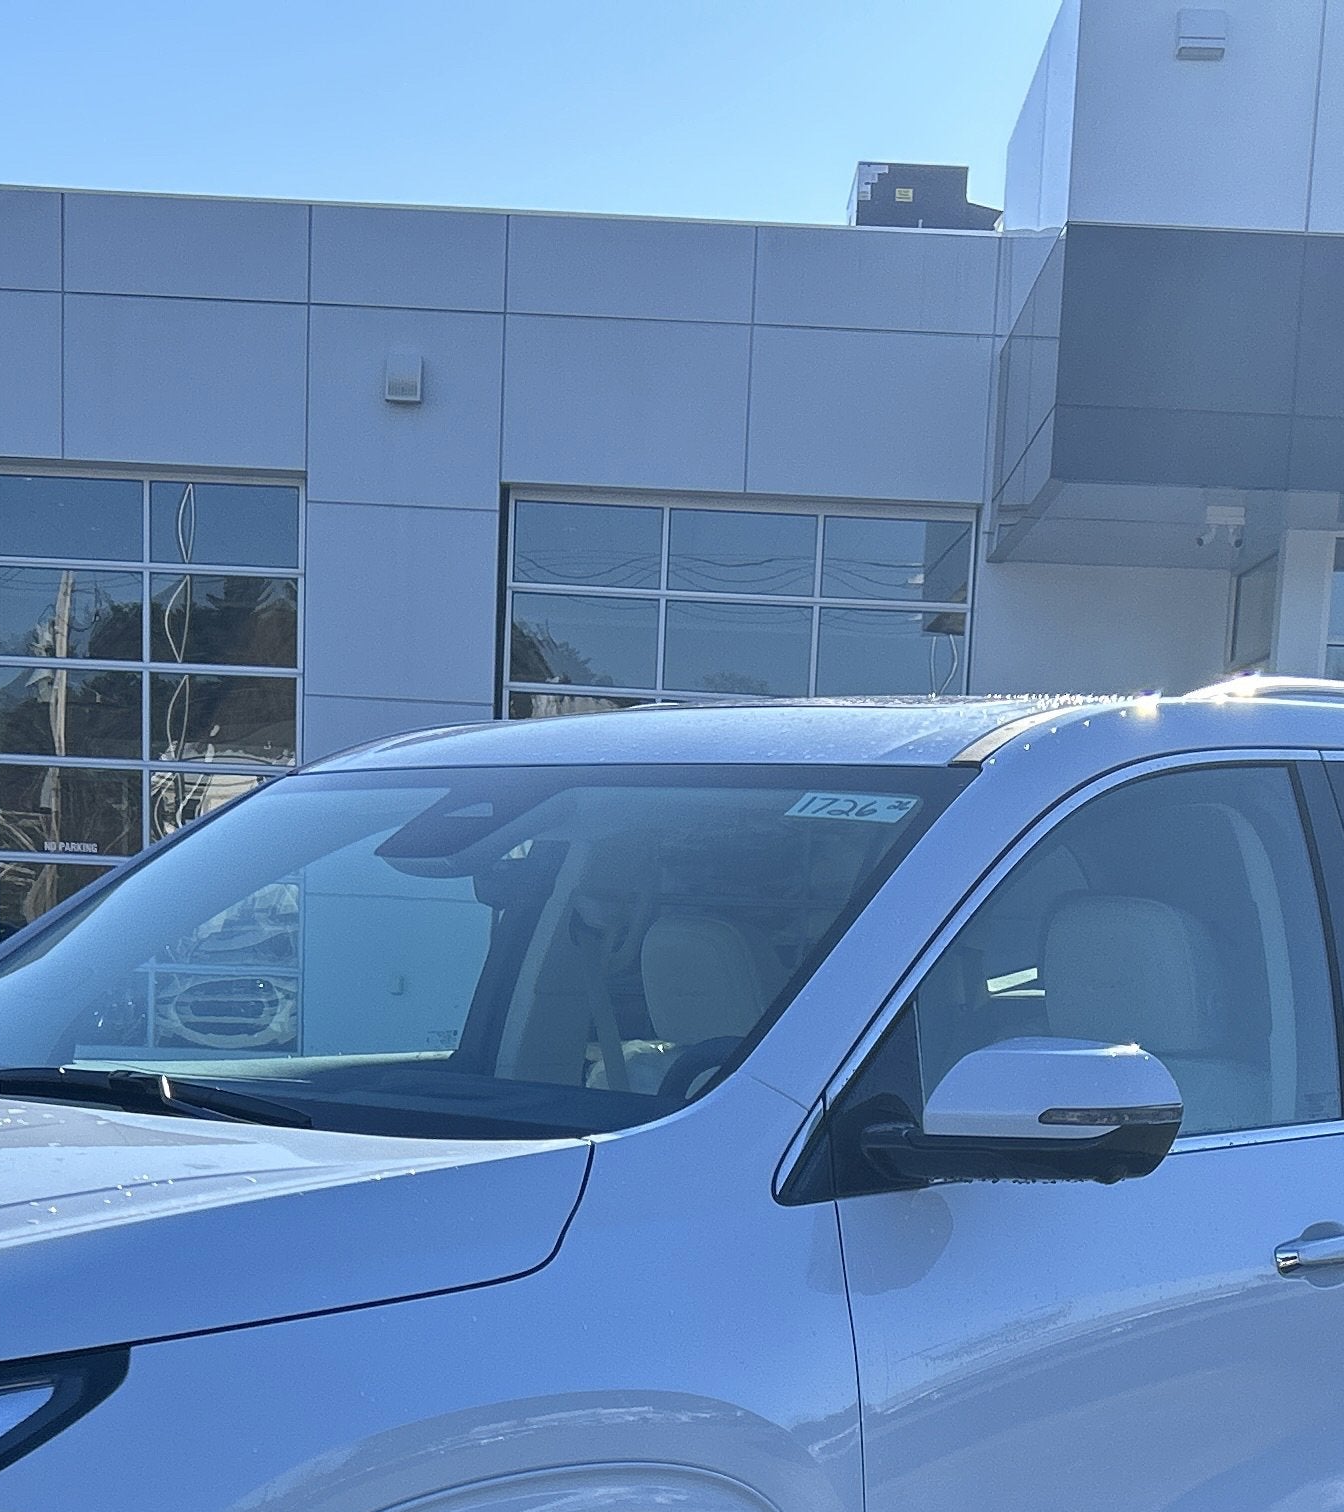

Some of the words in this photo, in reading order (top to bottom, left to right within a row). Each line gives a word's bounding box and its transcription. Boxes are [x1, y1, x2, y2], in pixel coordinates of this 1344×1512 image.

[797, 796, 878, 817] 1726
[43, 841, 57, 852] NO
[58, 842, 98, 854] PARKING
